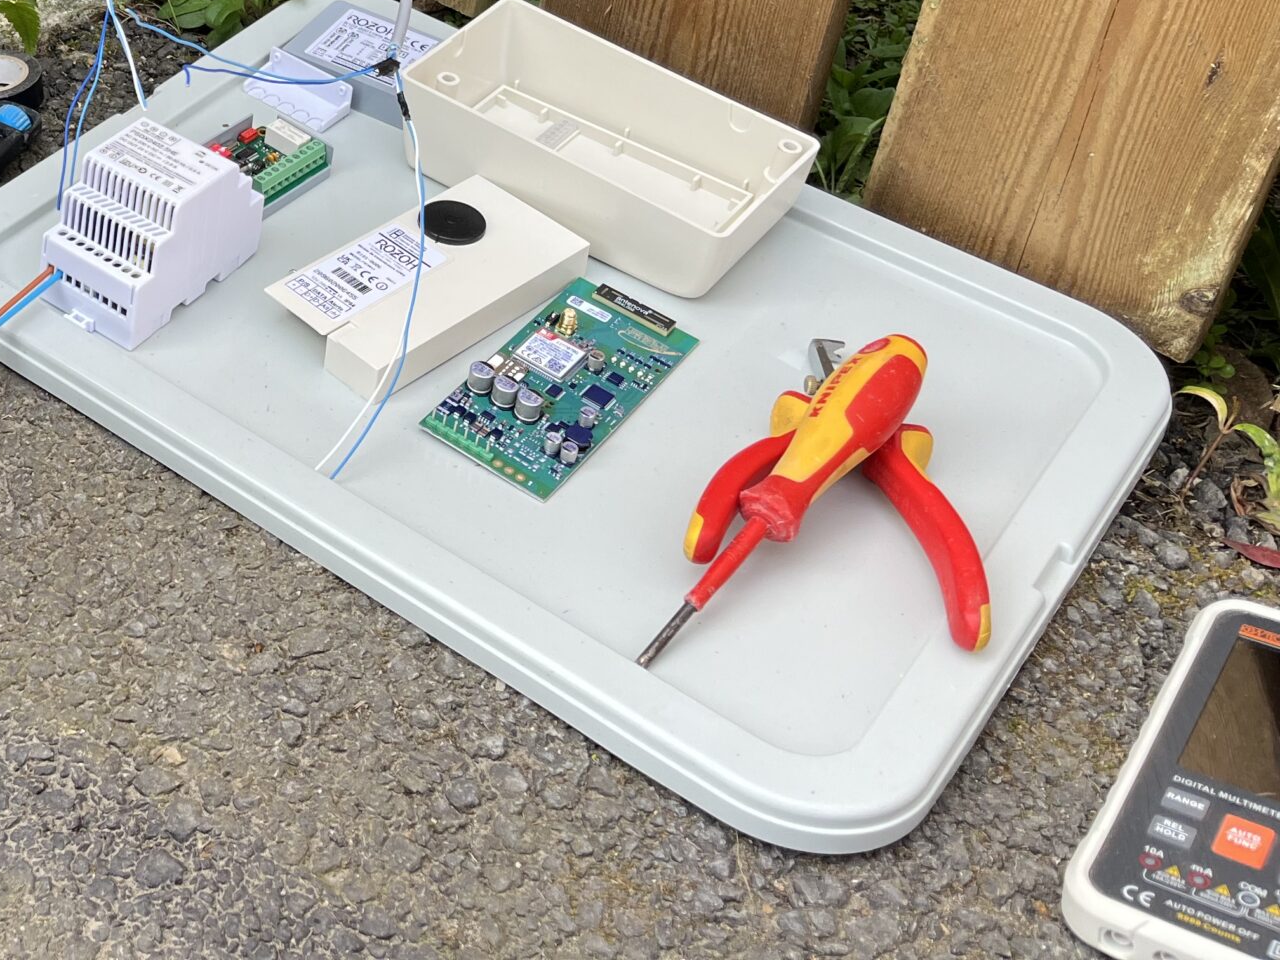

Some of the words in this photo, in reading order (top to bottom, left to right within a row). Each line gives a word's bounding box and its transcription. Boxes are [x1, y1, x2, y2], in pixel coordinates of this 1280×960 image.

[809, 357, 863, 417] KNIPEX
[1173, 774, 1216, 795] DIGITAL
[1166, 791, 1205, 811] RANGE
[1154, 825, 1186, 841] HOLD
[1163, 818, 1185, 831] REL
[1227, 834, 1260, 851] FUNC
[1230, 827, 1262, 841] AUTO
[1144, 845, 1164, 858] 10A
[1190, 864, 1213, 878] mA
[1238, 881, 1267, 898] COM
[1164, 899, 1195, 916] AUTO
[1197, 910, 1237, 931] POWER
[1239, 927, 1260, 940] OFF
[1203, 921, 1242, 943] Counts
